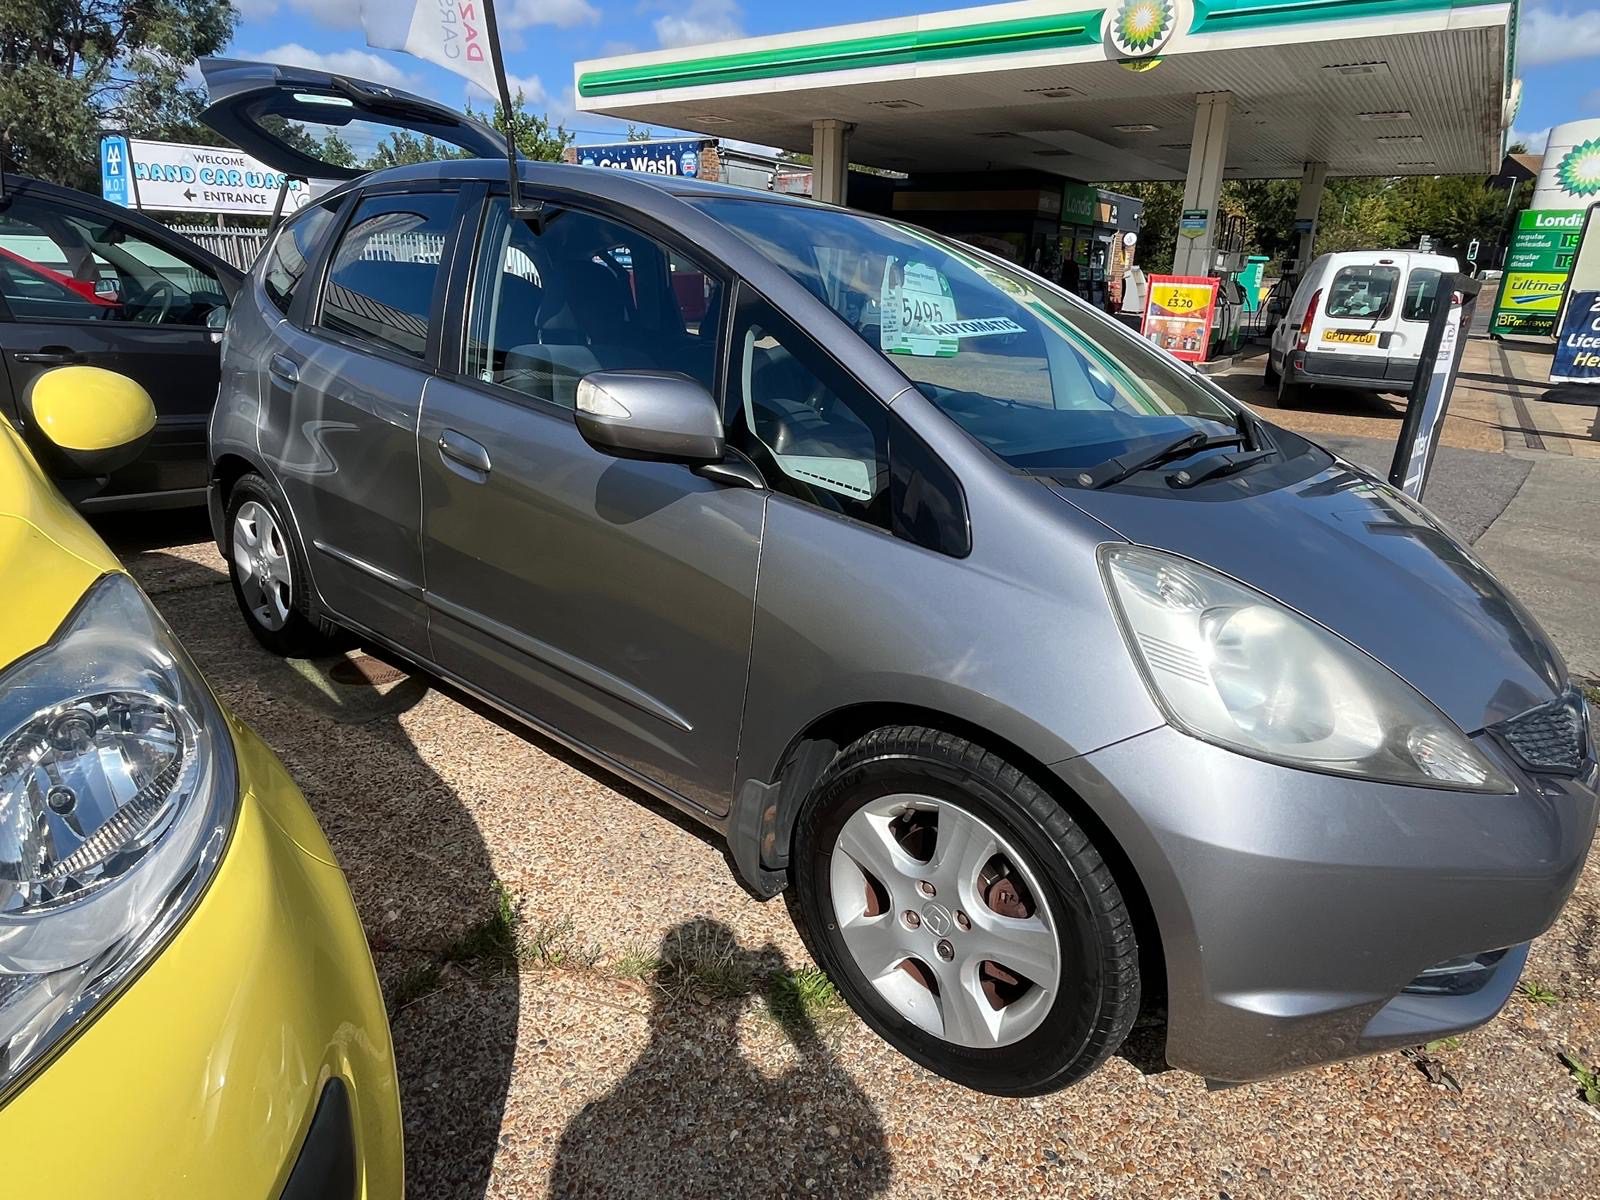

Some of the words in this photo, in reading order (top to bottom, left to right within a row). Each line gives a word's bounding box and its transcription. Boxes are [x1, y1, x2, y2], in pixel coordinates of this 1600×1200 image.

[193, 154, 245, 167] WELCOME
[630, 154, 677, 176] Wash
[134, 162, 196, 184] HAND
[199, 168, 244, 187] CAR
[105, 178, 125, 192] M.O.T
[204, 191, 267, 205] ENTRANCE
[1517, 233, 1546, 242] regular
[1512, 253, 1541, 261] regular
[1173, 289, 1179, 297] 2
[1167, 298, 1193, 308] £3.20
[902, 298, 943, 327] 5495
[930, 318, 1018, 336] AUTOMATIC
[1573, 352, 1600, 367] He
